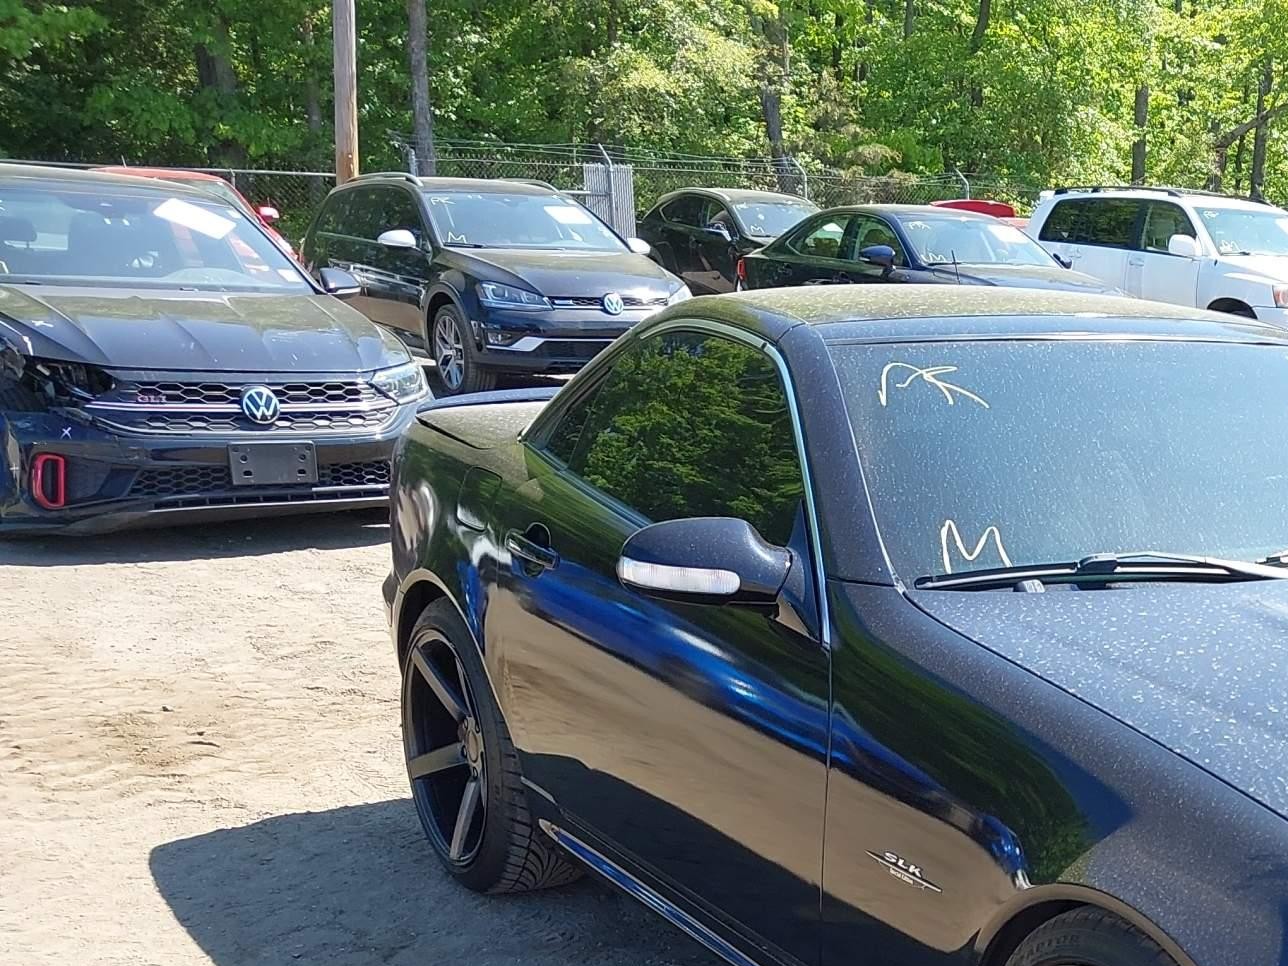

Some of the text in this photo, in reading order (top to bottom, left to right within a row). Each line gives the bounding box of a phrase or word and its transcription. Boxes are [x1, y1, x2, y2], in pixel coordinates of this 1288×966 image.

[447, 231, 467, 244] M
[242, 386, 281, 424] VW
[941, 519, 1014, 575] M
[884, 851, 922, 878] SLK
